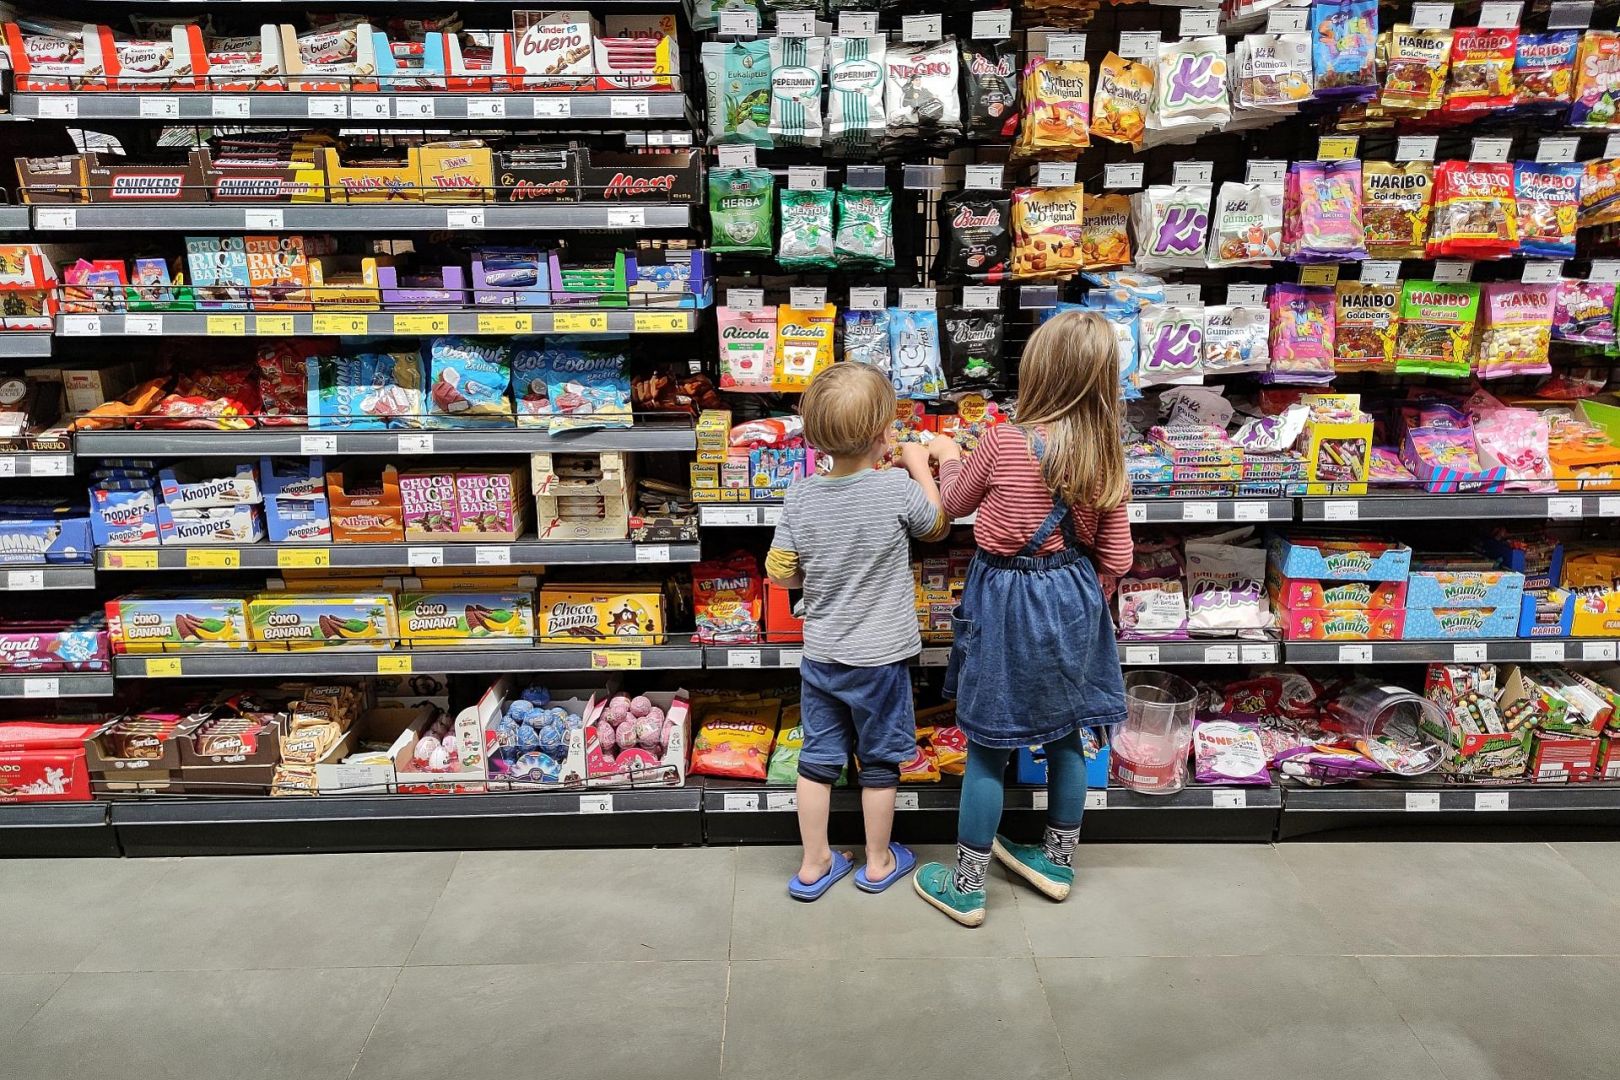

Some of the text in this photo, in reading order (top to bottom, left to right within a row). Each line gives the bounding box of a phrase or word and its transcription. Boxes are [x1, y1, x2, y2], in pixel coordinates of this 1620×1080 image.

[537, 25, 565, 34] Kinder
[31, 41, 65, 52] bueno
[224, 40, 252, 51] bueno
[311, 39, 338, 54] bueno
[524, 34, 581, 55] bueno
[1399, 36, 1444, 50] HARIBO
[1458, 36, 1509, 51] HARIBO
[1520, 43, 1568, 58] HARIBO
[124, 52, 156, 65] bueno
[1254, 61, 1288, 69] Gumioza
[728, 71, 768, 79] Eukaliptus
[834, 71, 877, 81] PEPERMINT
[889, 62, 950, 79] NEGRO
[772, 78, 816, 86] PEPERMINT
[1040, 70, 1083, 88] Werther's
[1103, 77, 1147, 104] Karamela
[709, 72, 717, 126] MIESZKO
[115, 178, 180, 194] SNICKERS
[604, 173, 676, 199] Mars
[1370, 174, 1426, 190] HARIBO
[1452, 172, 1509, 187] HARIBO
[1521, 173, 1577, 190] HARIBO
[218, 180, 279, 196] SNICKERS
[510, 180, 568, 201] Mars
[1373, 191, 1422, 201] Goldbears
[722, 197, 761, 210] HERBA
[848, 204, 884, 214] MENTOL
[1025, 200, 1077, 213] Werther's
[788, 206, 826, 216] MENTOL
[952, 205, 1000, 228] Bronhi
[1038, 211, 1076, 223] Original
[1083, 215, 1127, 227] aramela
[1223, 214, 1264, 224] Gumioza
[187, 239, 244, 252] CHOCO
[245, 238, 304, 252] CHOCO
[188, 252, 246, 269] RICE
[247, 253, 306, 269] RICE
[193, 267, 233, 281] BARS
[250, 267, 292, 280] BARS
[1342, 294, 1395, 308] HARIBO
[1411, 292, 1470, 307] HARIBO
[1500, 291, 1548, 308] HARIBO
[1346, 311, 1390, 320] Goldbears
[723, 326, 770, 339] Ricola
[782, 324, 825, 337] Ricola
[848, 325, 881, 335] MENTOL
[954, 324, 996, 344] Bronhi
[919, 327, 933, 348] fresh
[433, 338, 506, 363] Coconut
[553, 353, 624, 373] Coconut
[963, 401, 985, 409] Chupa
[962, 408, 985, 417] Chups
[1167, 433, 1204, 442] mentos
[32, 441, 66, 450] FERRERO
[1179, 454, 1222, 464] mentos
[1129, 472, 1152, 480] ntos
[1178, 470, 1222, 480] mentos
[1246, 470, 1281, 478] mentos
[281, 483, 314, 495] Knoppers
[400, 475, 453, 490] CHOCO
[456, 475, 510, 490] CHOCO
[181, 480, 235, 502] Knoppers
[403, 487, 454, 505] RICE
[459, 486, 511, 503] RICE
[405, 502, 442, 514] BARS
[460, 501, 498, 513] BARS
[340, 517, 379, 527] Albeni
[109, 529, 144, 542] Knoppers
[178, 519, 231, 539] Knoppers
[288, 525, 321, 538] Knoppers
[1327, 559, 1374, 571] Mamba
[1325, 591, 1372, 605] Mamba
[1445, 584, 1487, 599] Mamba
[416, 603, 444, 616] ČOKO
[552, 602, 593, 616] Choco
[133, 610, 160, 626] ČOKO
[268, 610, 298, 626] ČOKO
[409, 617, 457, 630] BANANA
[549, 613, 597, 631] Banana
[1441, 615, 1483, 629] Mamba
[128, 626, 172, 638] BANANA
[263, 626, 312, 639] BANANA
[1325, 621, 1371, 636] Mamba
[1531, 626, 1561, 635] HARIBO
[313, 687, 340, 695] Tortica
[131, 738, 160, 748] Tortica
[212, 739, 241, 750] Tortica
[287, 741, 315, 752] Tortica
